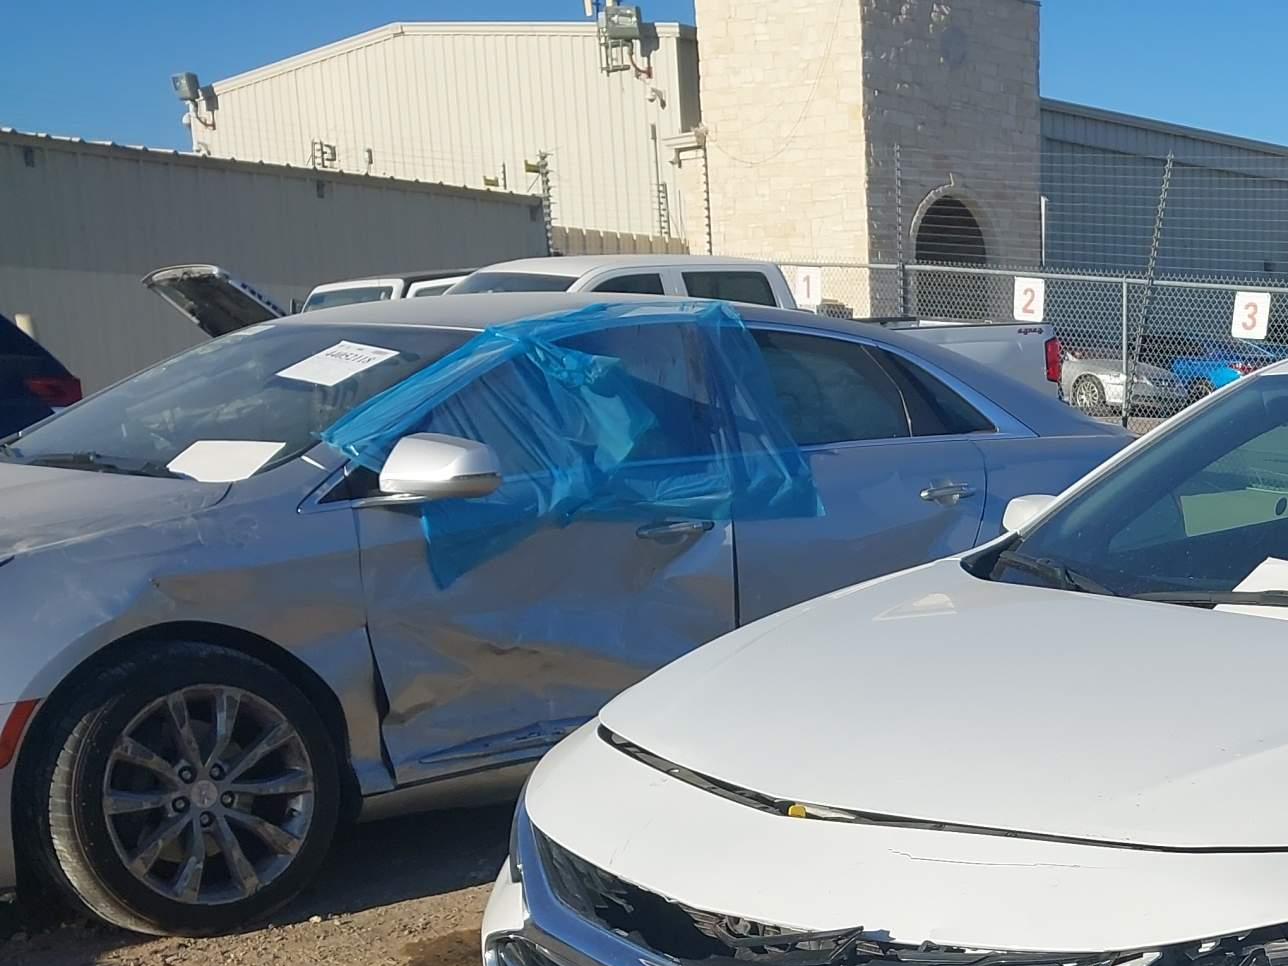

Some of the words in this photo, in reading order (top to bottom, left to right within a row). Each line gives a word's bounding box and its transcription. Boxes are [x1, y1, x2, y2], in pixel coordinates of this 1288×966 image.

[803, 274, 811, 299] 1
[1022, 287, 1036, 314] 2
[1241, 301, 1258, 331] 3
